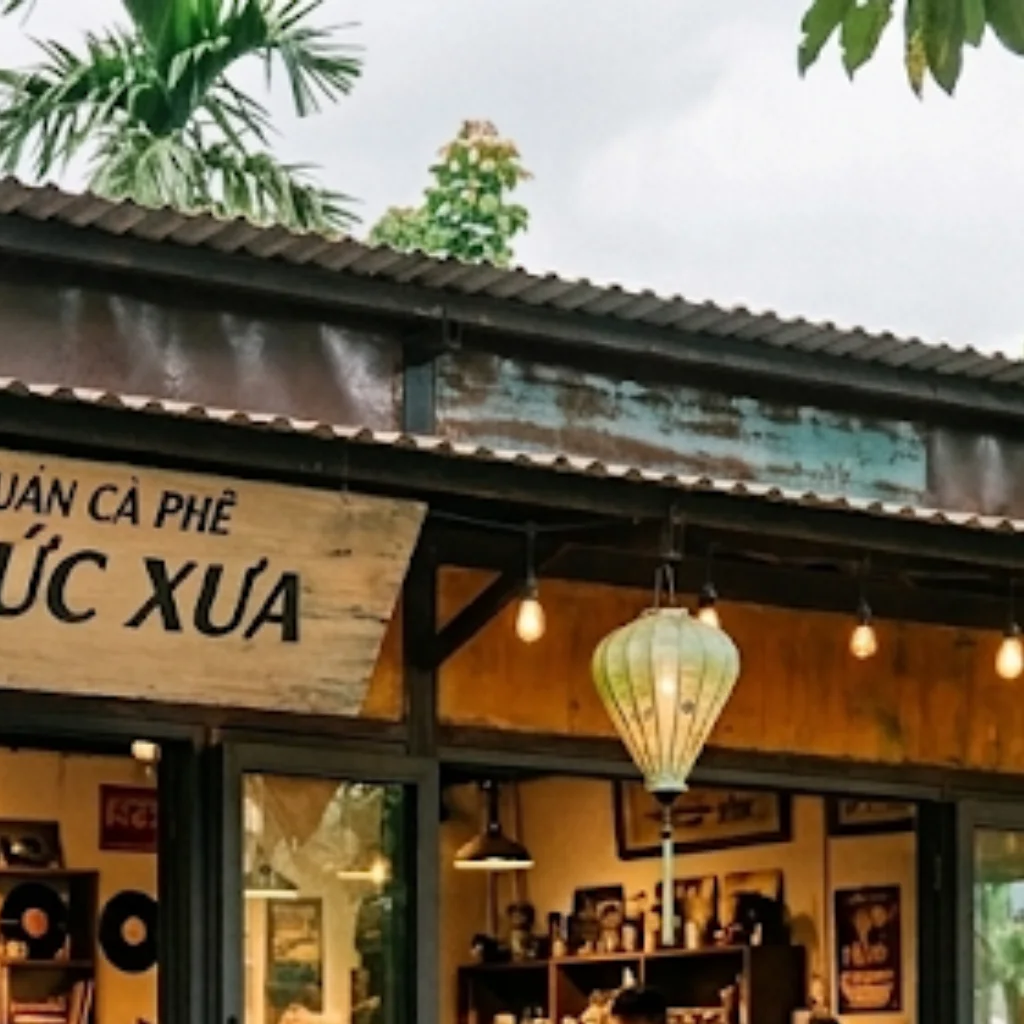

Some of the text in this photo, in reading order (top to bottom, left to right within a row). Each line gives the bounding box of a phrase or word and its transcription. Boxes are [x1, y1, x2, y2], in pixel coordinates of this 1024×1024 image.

[87, 475, 140, 526] CÀ
[153, 487, 238, 537] PHÊ
[123, 555, 302, 644] XƯA
